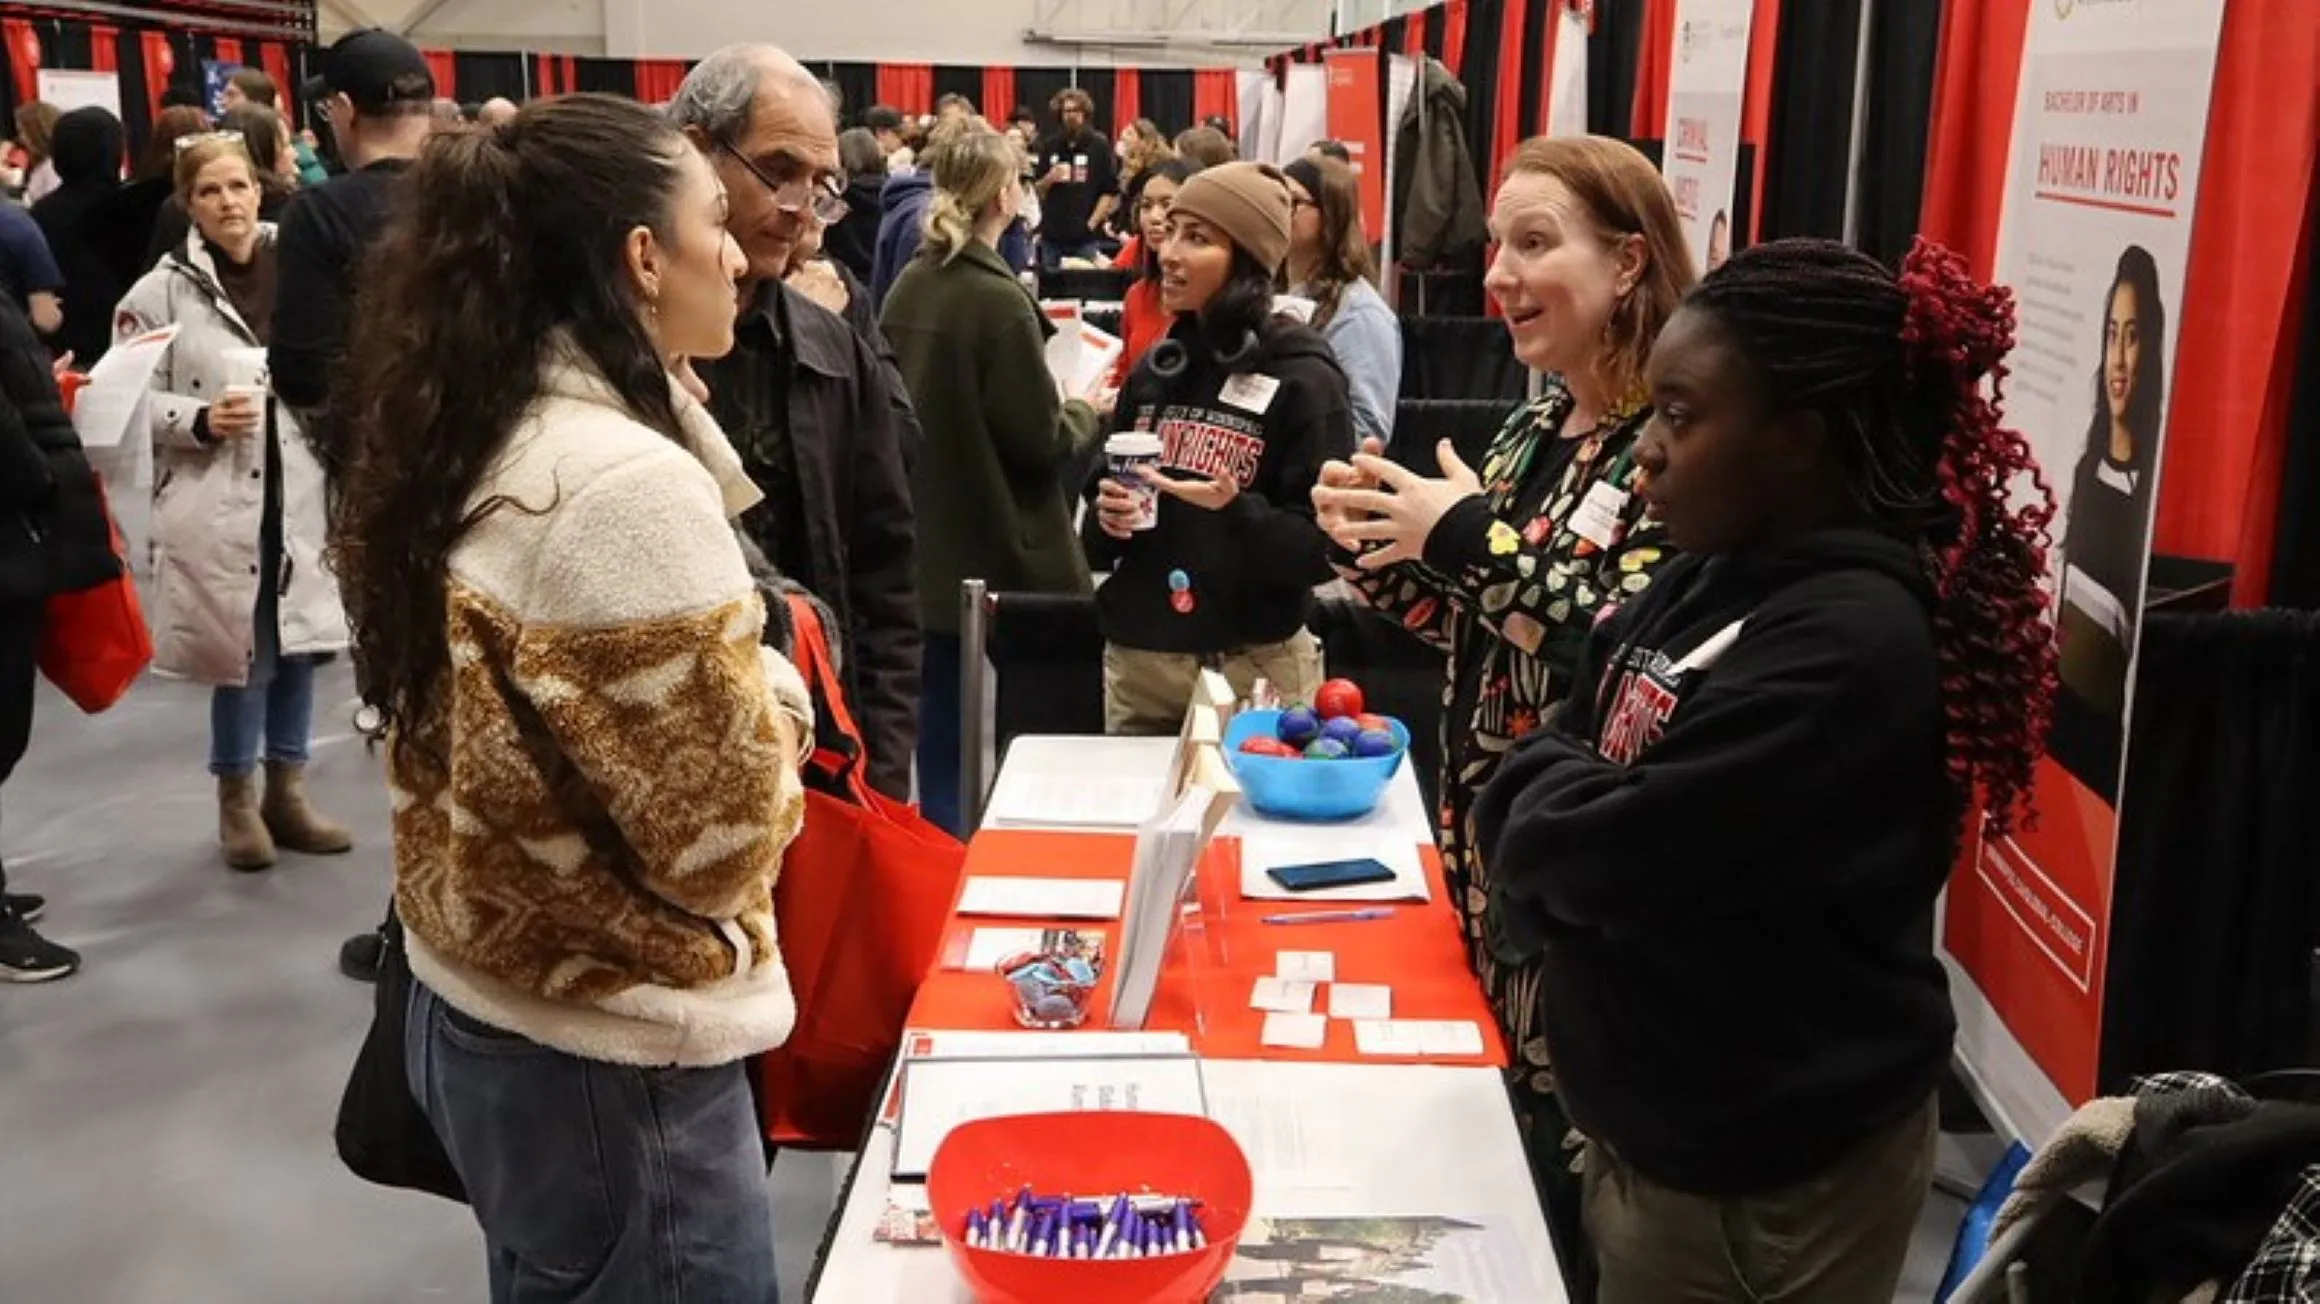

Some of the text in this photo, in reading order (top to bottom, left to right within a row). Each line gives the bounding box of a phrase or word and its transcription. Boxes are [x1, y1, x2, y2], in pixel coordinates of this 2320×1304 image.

[2043, 91, 2138, 114] BACHELOR OF ARTS IN
[2037, 142, 2181, 201] HUMAN RIGHTS
[1178, 422, 1266, 489] RIGHTS
